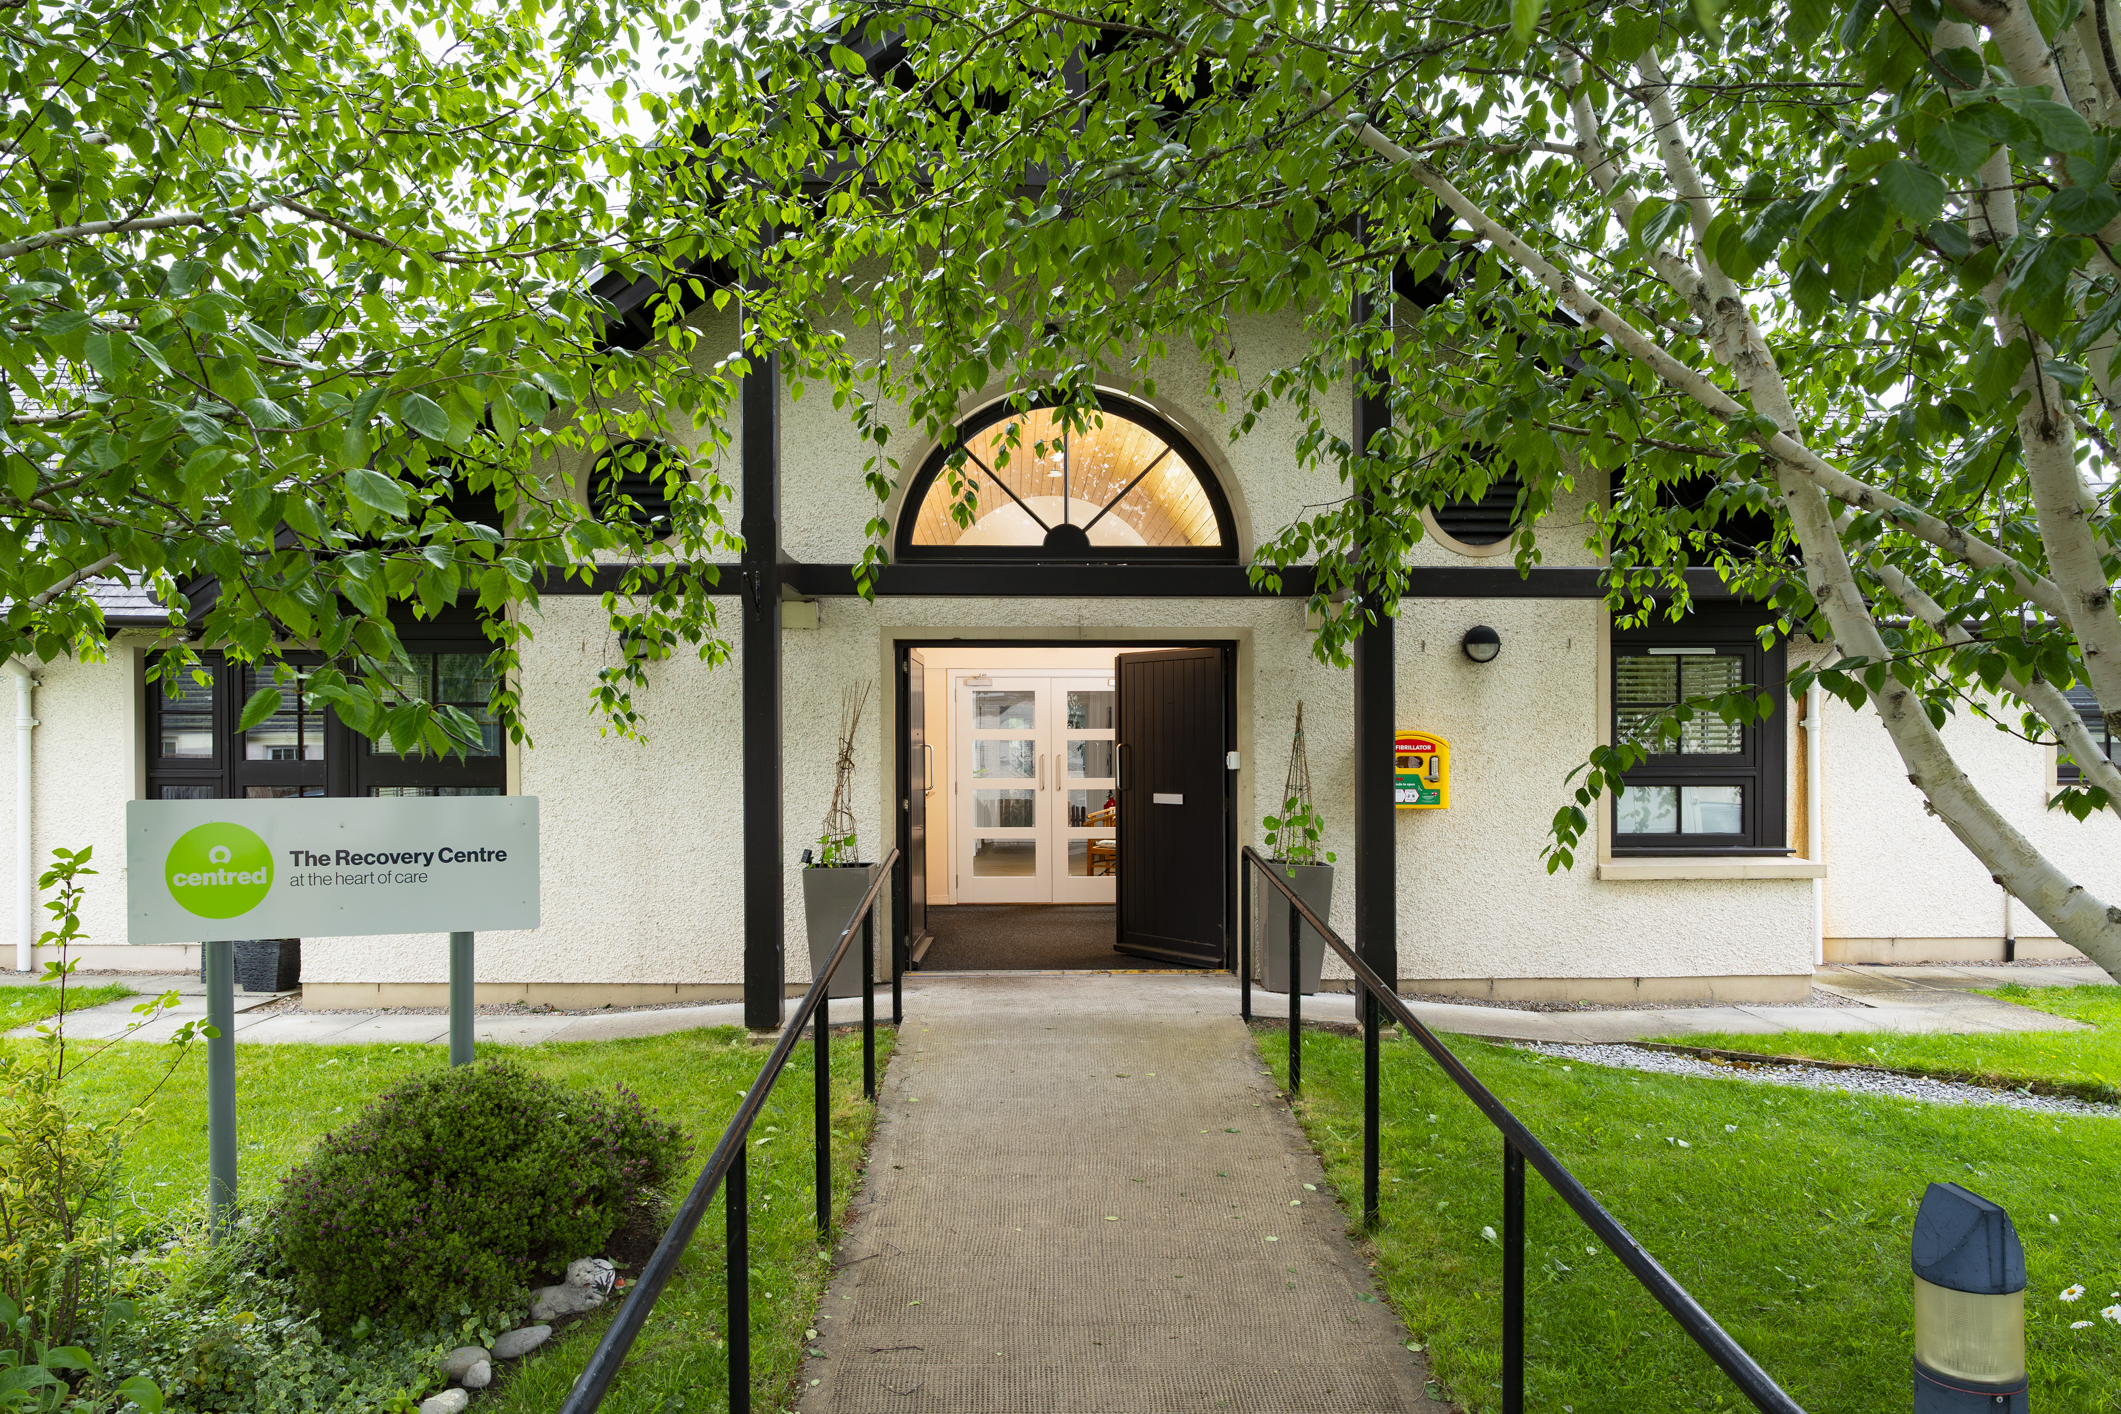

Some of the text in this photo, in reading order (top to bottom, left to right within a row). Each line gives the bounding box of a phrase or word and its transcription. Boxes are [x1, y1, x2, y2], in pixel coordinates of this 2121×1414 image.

[289, 846, 508, 867] The Recovery Centre
[172, 866, 267, 887] centred
[290, 870, 428, 887] at the heart of care
